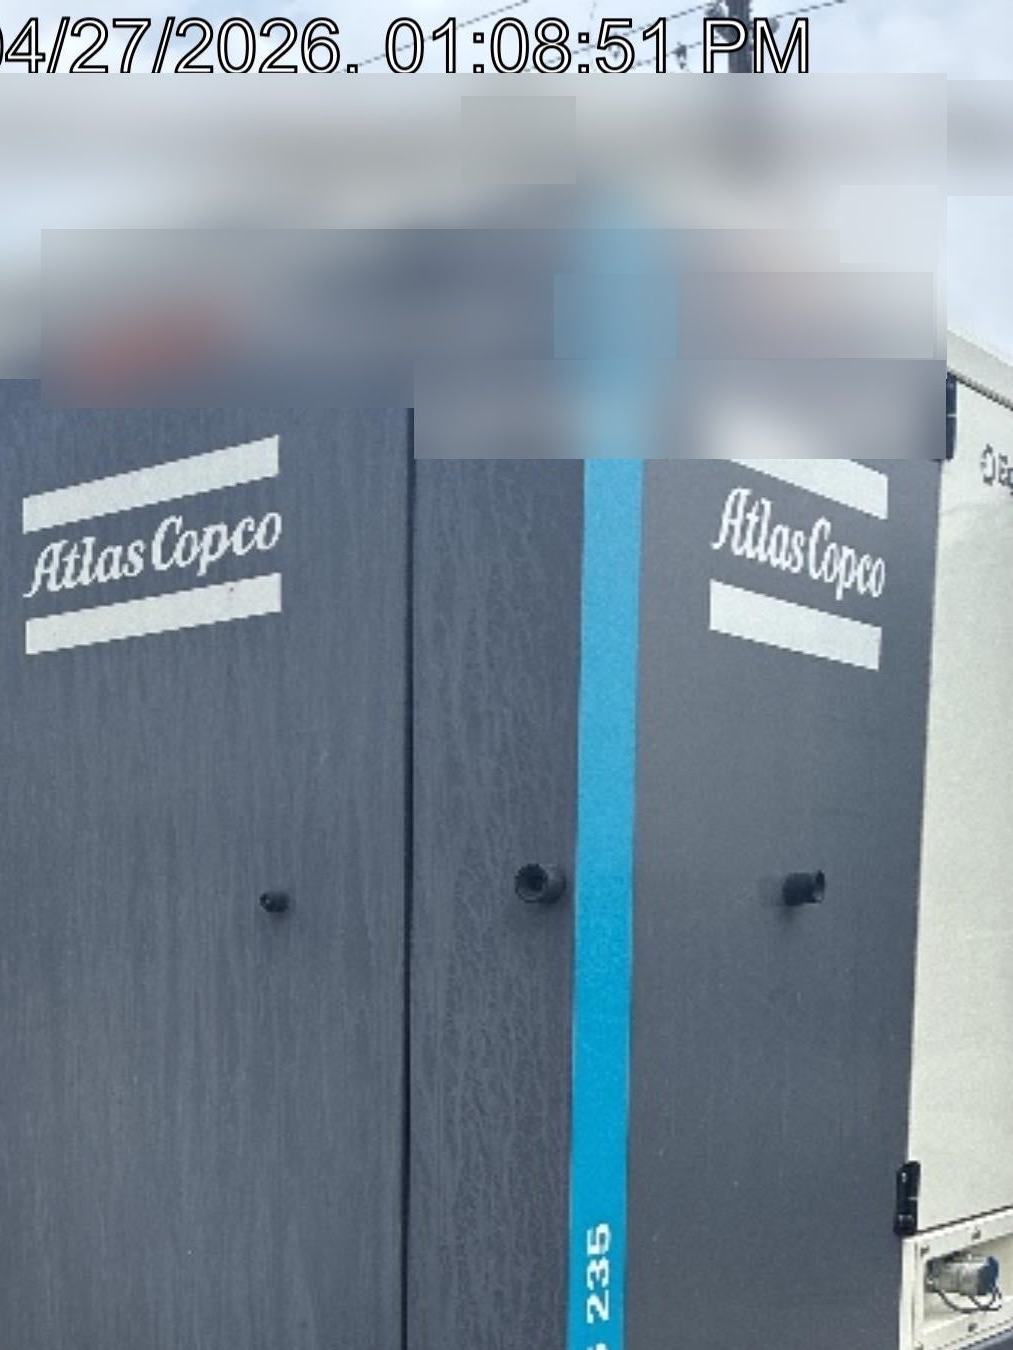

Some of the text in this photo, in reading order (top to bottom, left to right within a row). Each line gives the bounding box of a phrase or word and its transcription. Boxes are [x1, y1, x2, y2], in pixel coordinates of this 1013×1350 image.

[22, 511, 283, 599] Atlas Copco
[710, 486, 886, 601] Atlas Copco
[586, 1223, 612, 1324] 235
